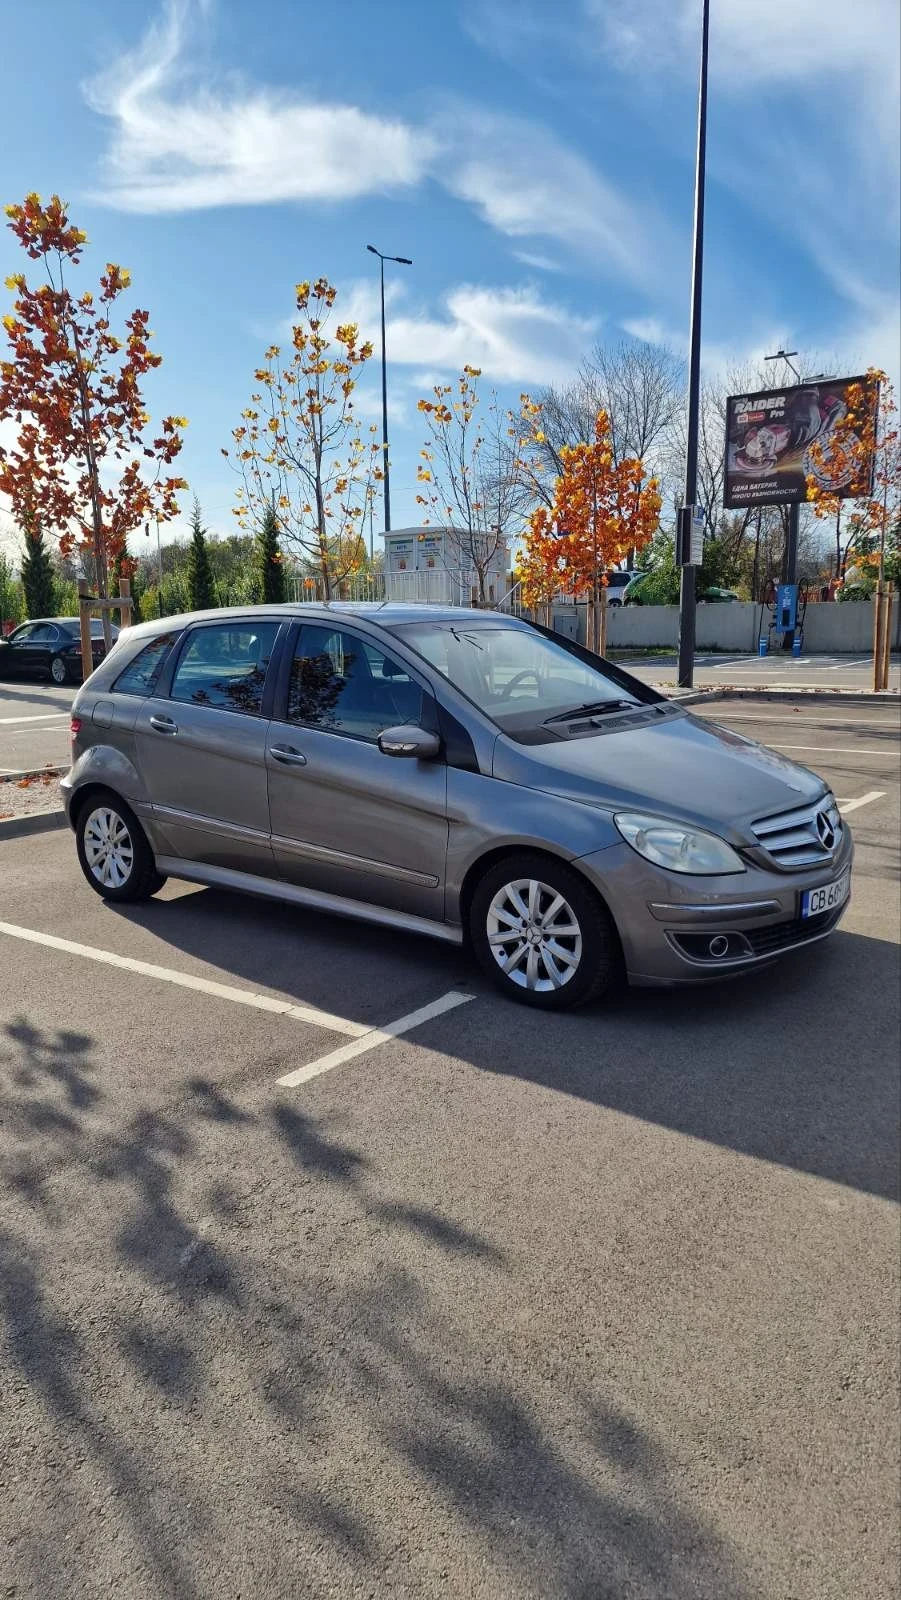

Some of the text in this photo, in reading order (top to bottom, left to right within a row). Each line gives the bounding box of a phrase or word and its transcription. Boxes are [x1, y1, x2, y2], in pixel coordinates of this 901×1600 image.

[735, 397, 785, 413] RAIDER
[770, 410, 785, 418] Pro
[811, 890, 825, 911] CB
